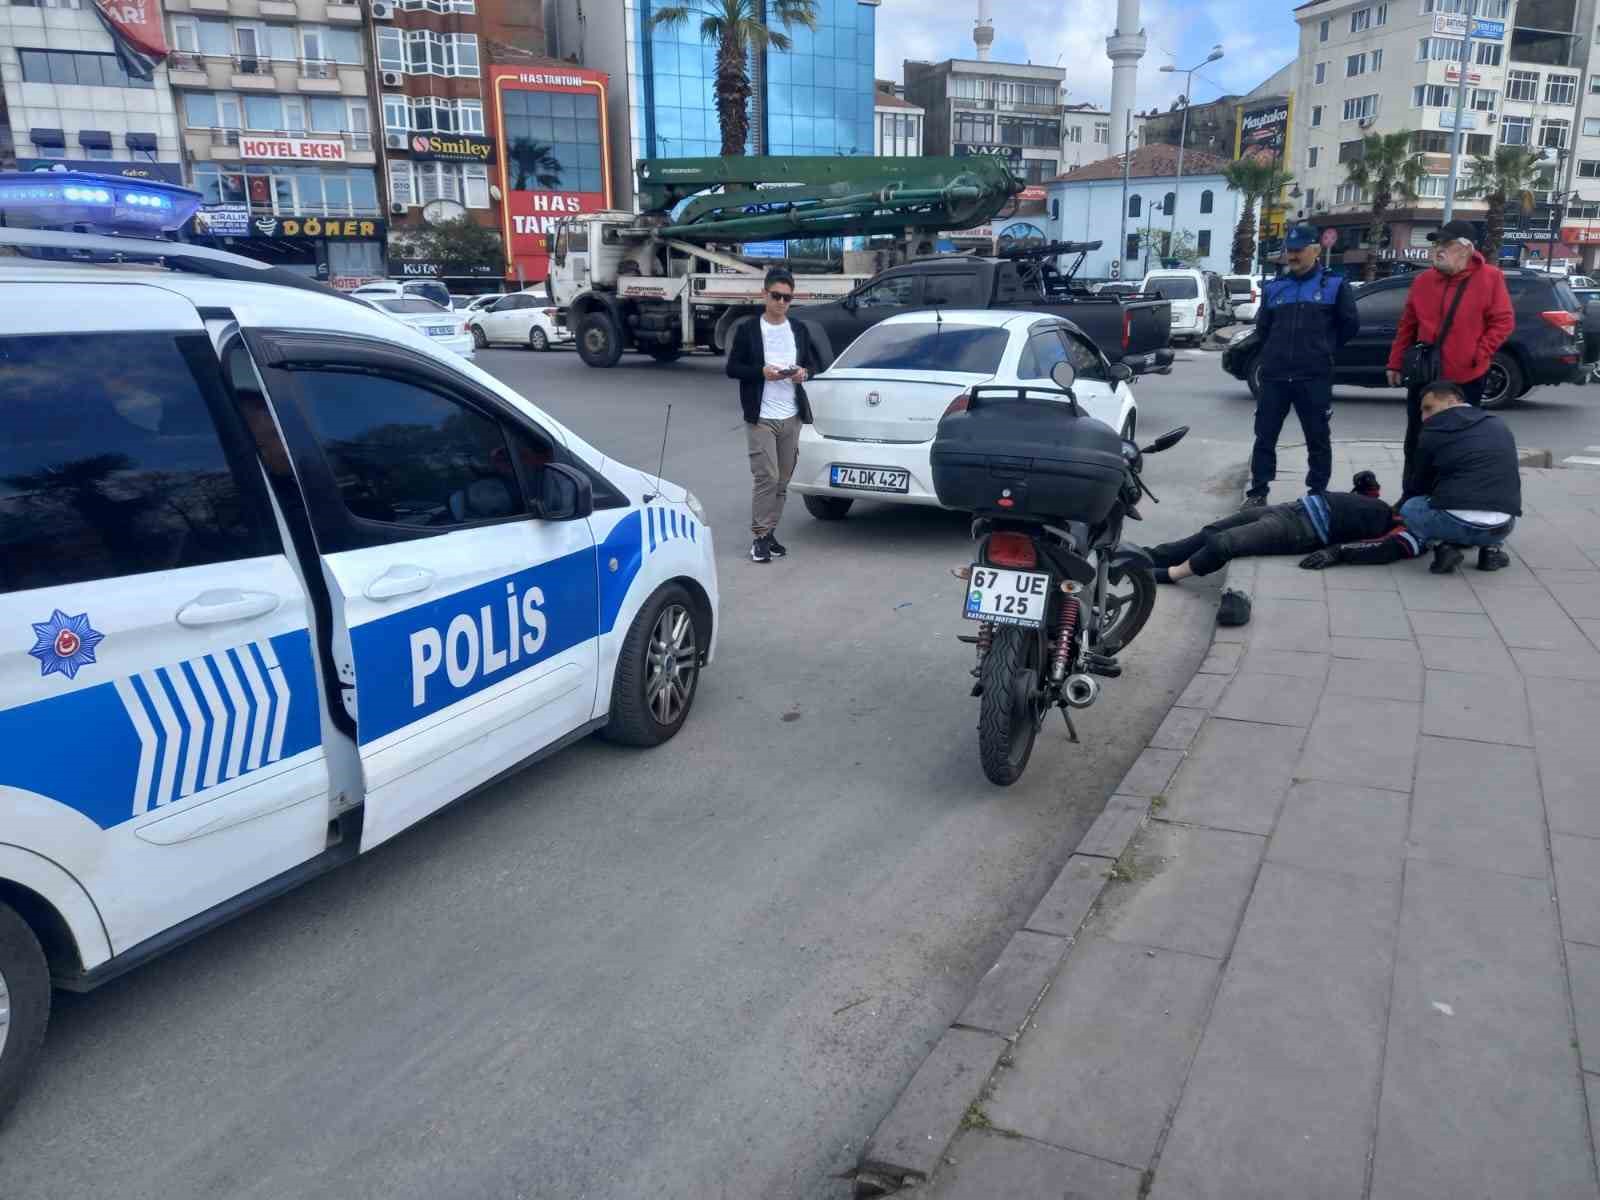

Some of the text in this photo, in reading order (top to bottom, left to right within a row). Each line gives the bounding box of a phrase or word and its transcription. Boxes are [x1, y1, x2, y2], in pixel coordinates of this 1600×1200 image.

[244, 141, 342, 158] HOTEL EKEN
[430, 137, 491, 159] Smiley
[533, 195, 580, 212] HAS
[840, 470, 906, 487] 74 DK 427
[974, 570, 1045, 595] 67 UE
[994, 594, 1029, 615] 125
[409, 581, 547, 708] POLİS
